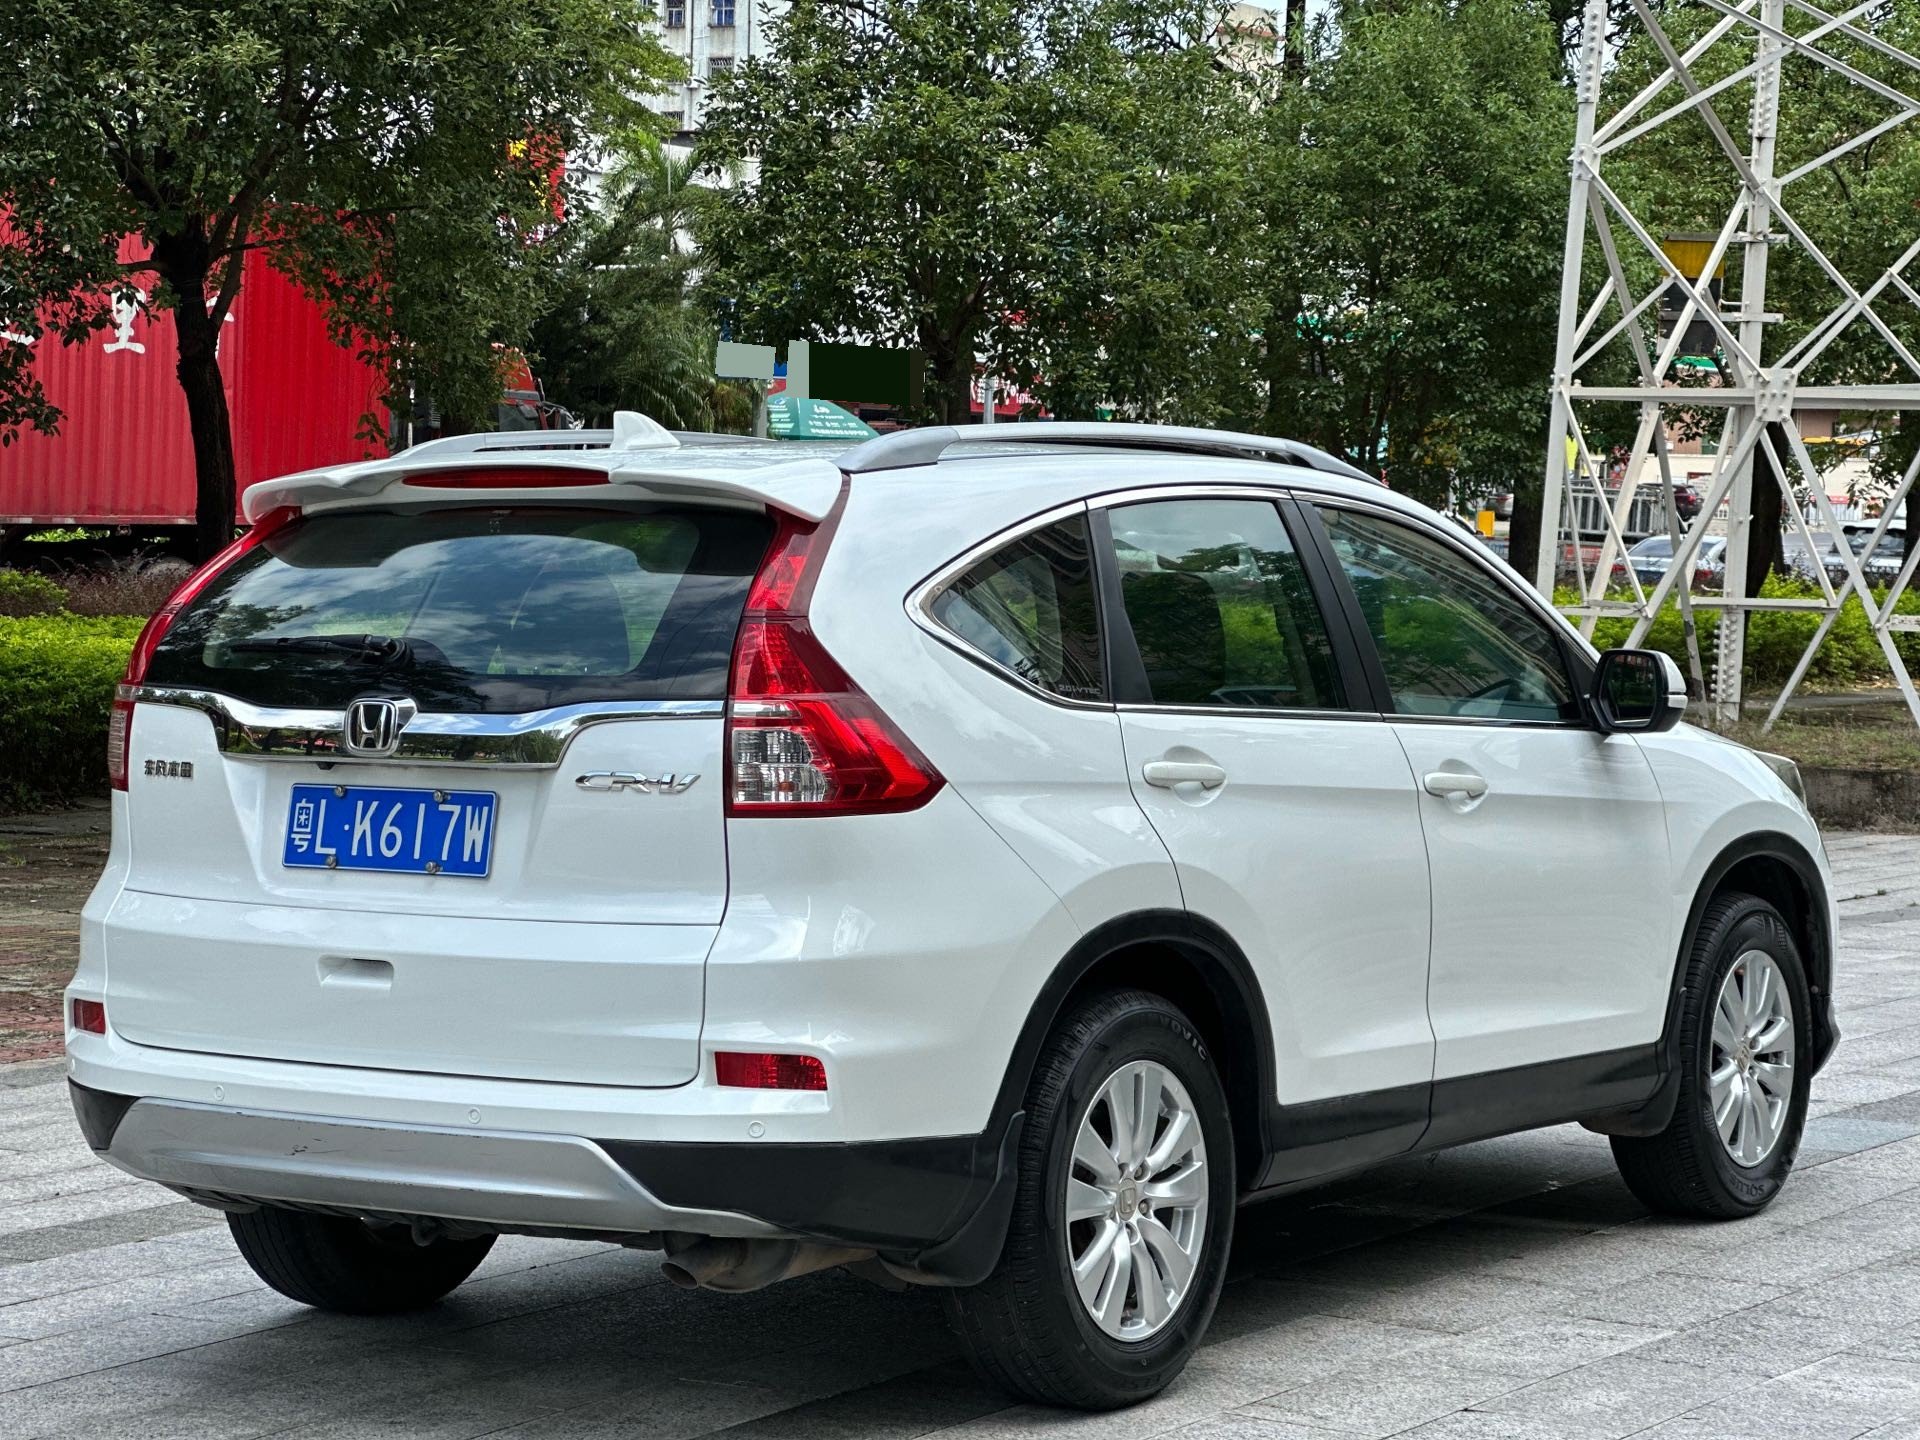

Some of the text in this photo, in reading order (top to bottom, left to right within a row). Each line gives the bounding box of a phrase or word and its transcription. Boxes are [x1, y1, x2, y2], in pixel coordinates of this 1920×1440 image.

[144, 759, 193, 778] 东风本田
[575, 770, 701, 794] CR-V
[290, 797, 489, 863] 粤L·K617W
